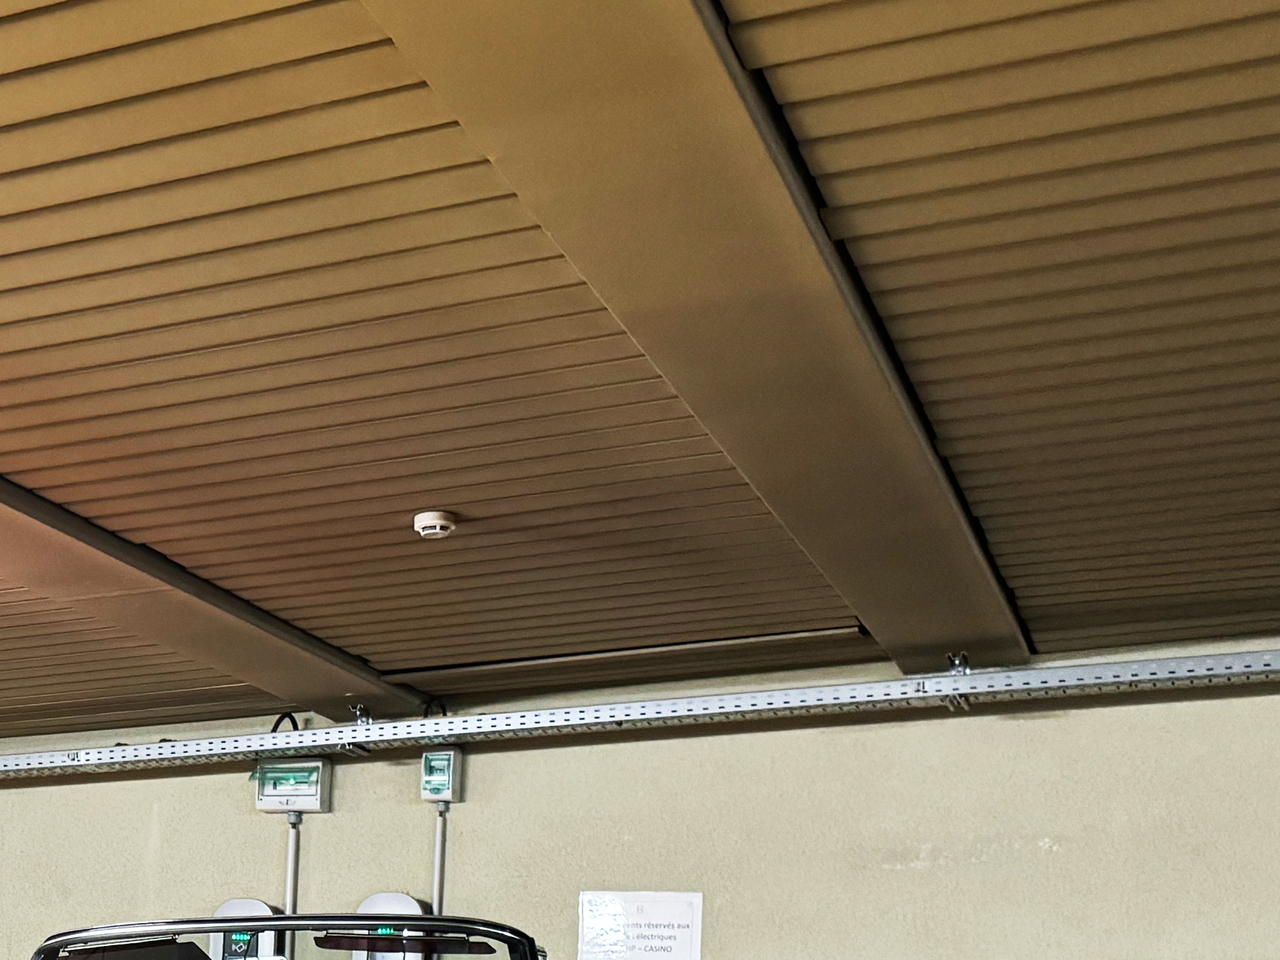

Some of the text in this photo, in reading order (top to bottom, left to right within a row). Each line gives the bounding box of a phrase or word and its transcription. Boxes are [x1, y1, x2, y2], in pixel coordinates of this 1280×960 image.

[643, 922, 675, 930] réservés
[636, 933, 677, 942] électriques
[643, 945, 673, 953] CASINO
